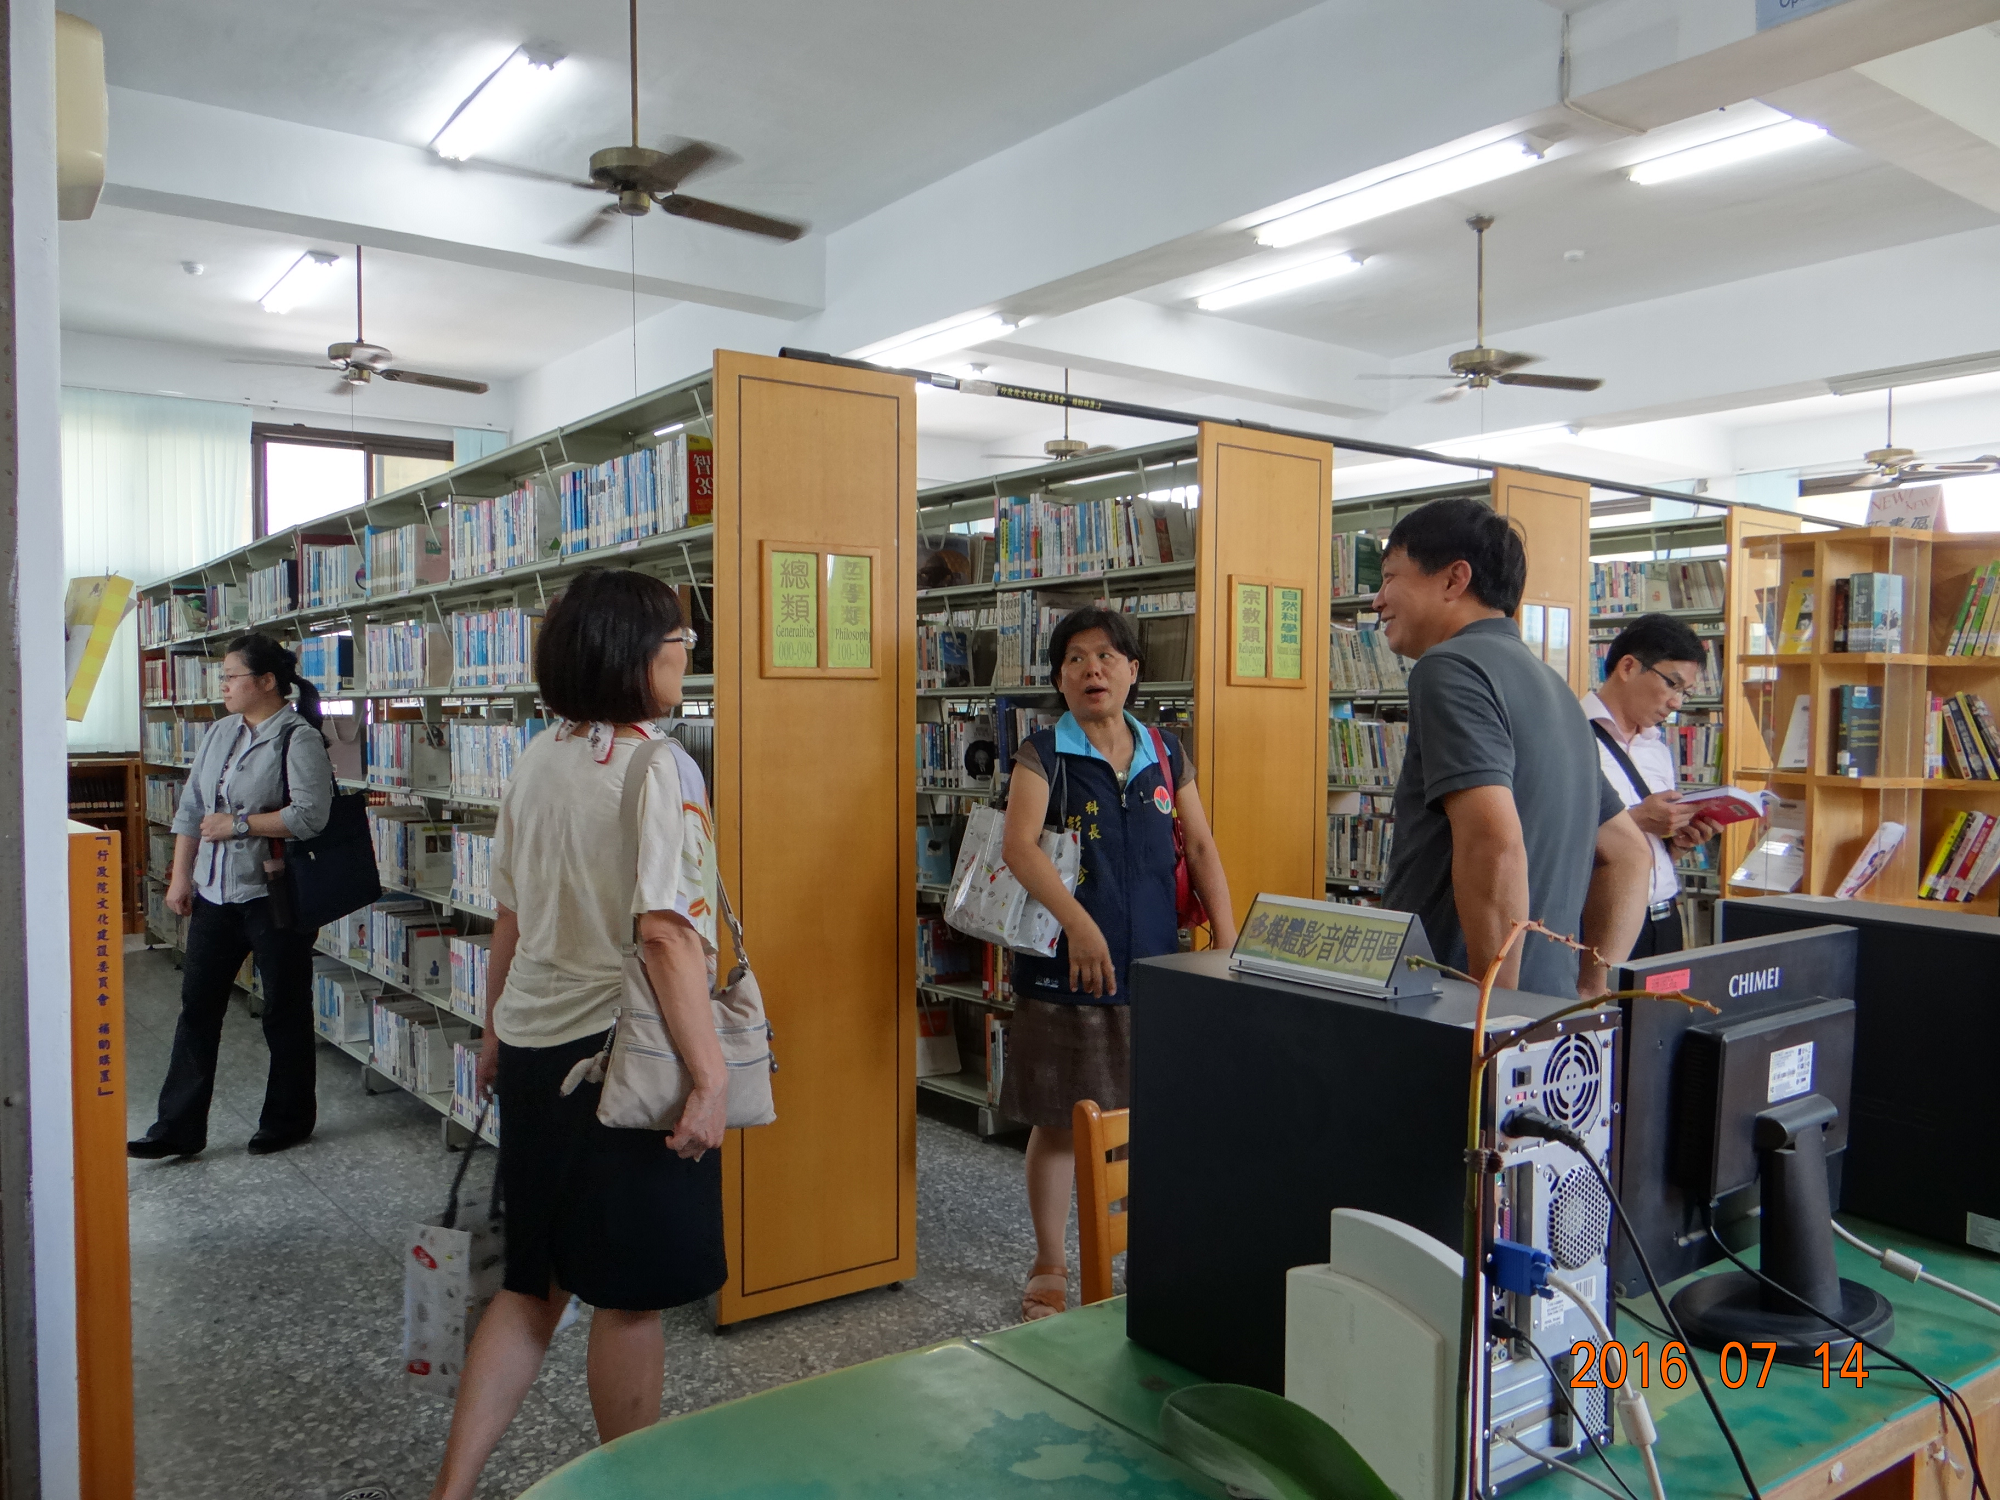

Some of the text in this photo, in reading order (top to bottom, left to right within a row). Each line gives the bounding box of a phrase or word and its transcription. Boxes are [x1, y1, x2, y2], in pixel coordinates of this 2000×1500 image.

[780, 558, 810, 624] 總類
[841, 559, 866, 626] 哲學類
[1242, 589, 1261, 643] 宗教類
[1280, 590, 1298, 644] 自然科學類
[775, 624, 815, 638] Generalities
[1085, 800, 1101, 840] 科長
[1249, 912, 1403, 963] 多媒體影音使用區
[1728, 966, 1780, 998] CHIMEI
